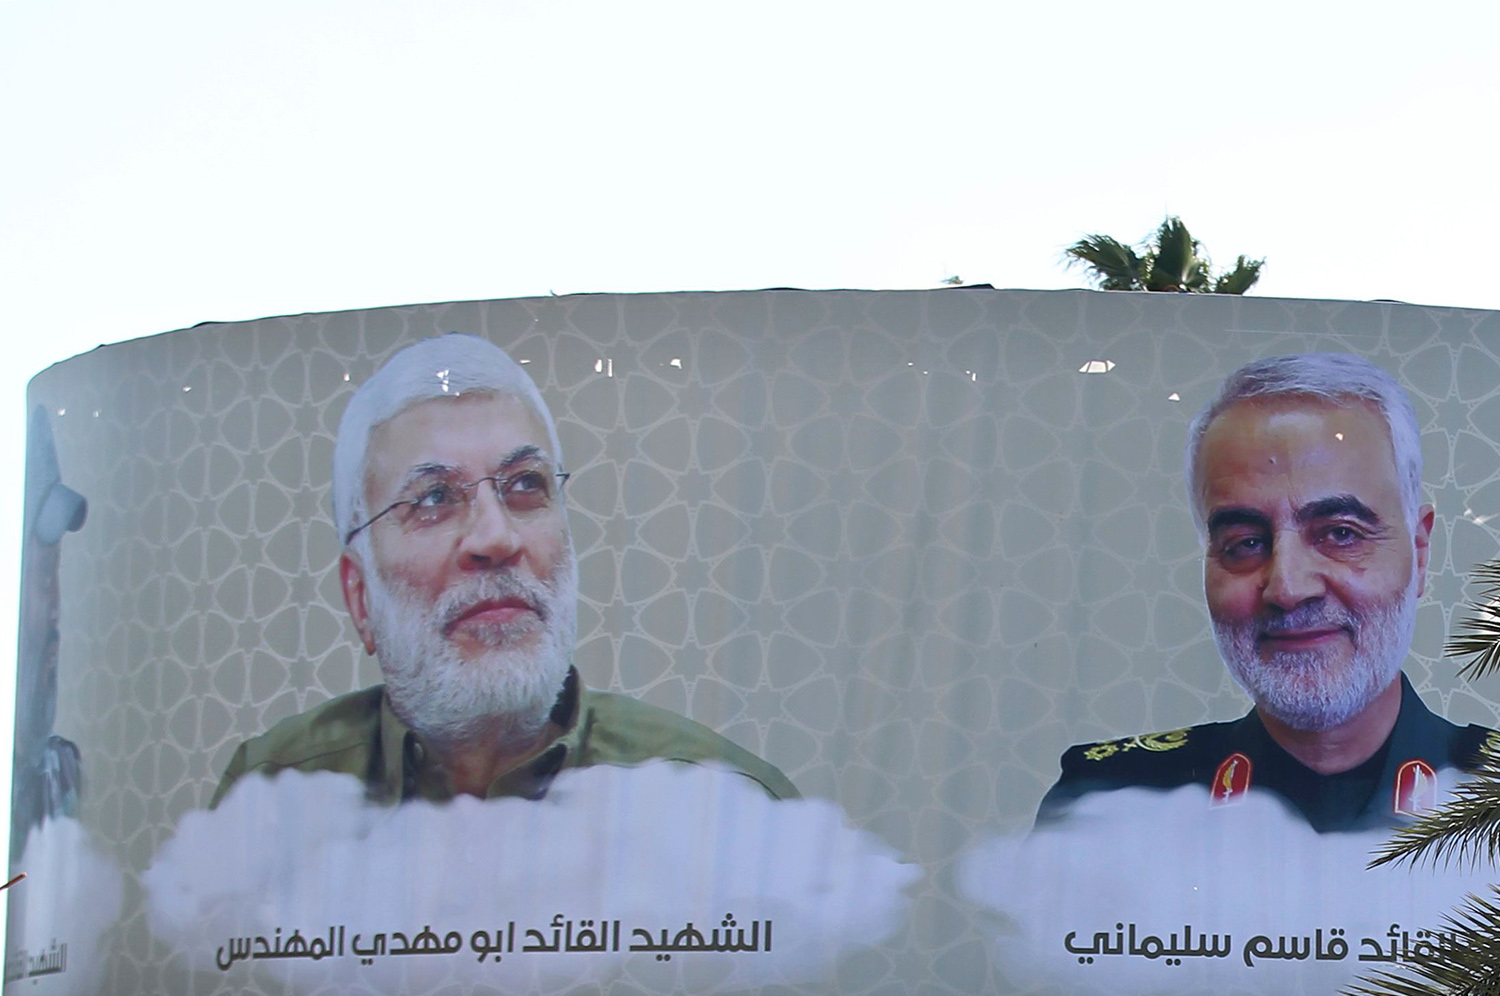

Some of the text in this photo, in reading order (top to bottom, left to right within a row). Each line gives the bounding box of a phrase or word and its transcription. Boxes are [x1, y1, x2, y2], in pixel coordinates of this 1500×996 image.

[216, 913, 773, 971] الشهيد القائد ابو مهدي المهندس
[1064, 923, 1232, 966] سليماني
[1243, 928, 1349, 967] قاسم
